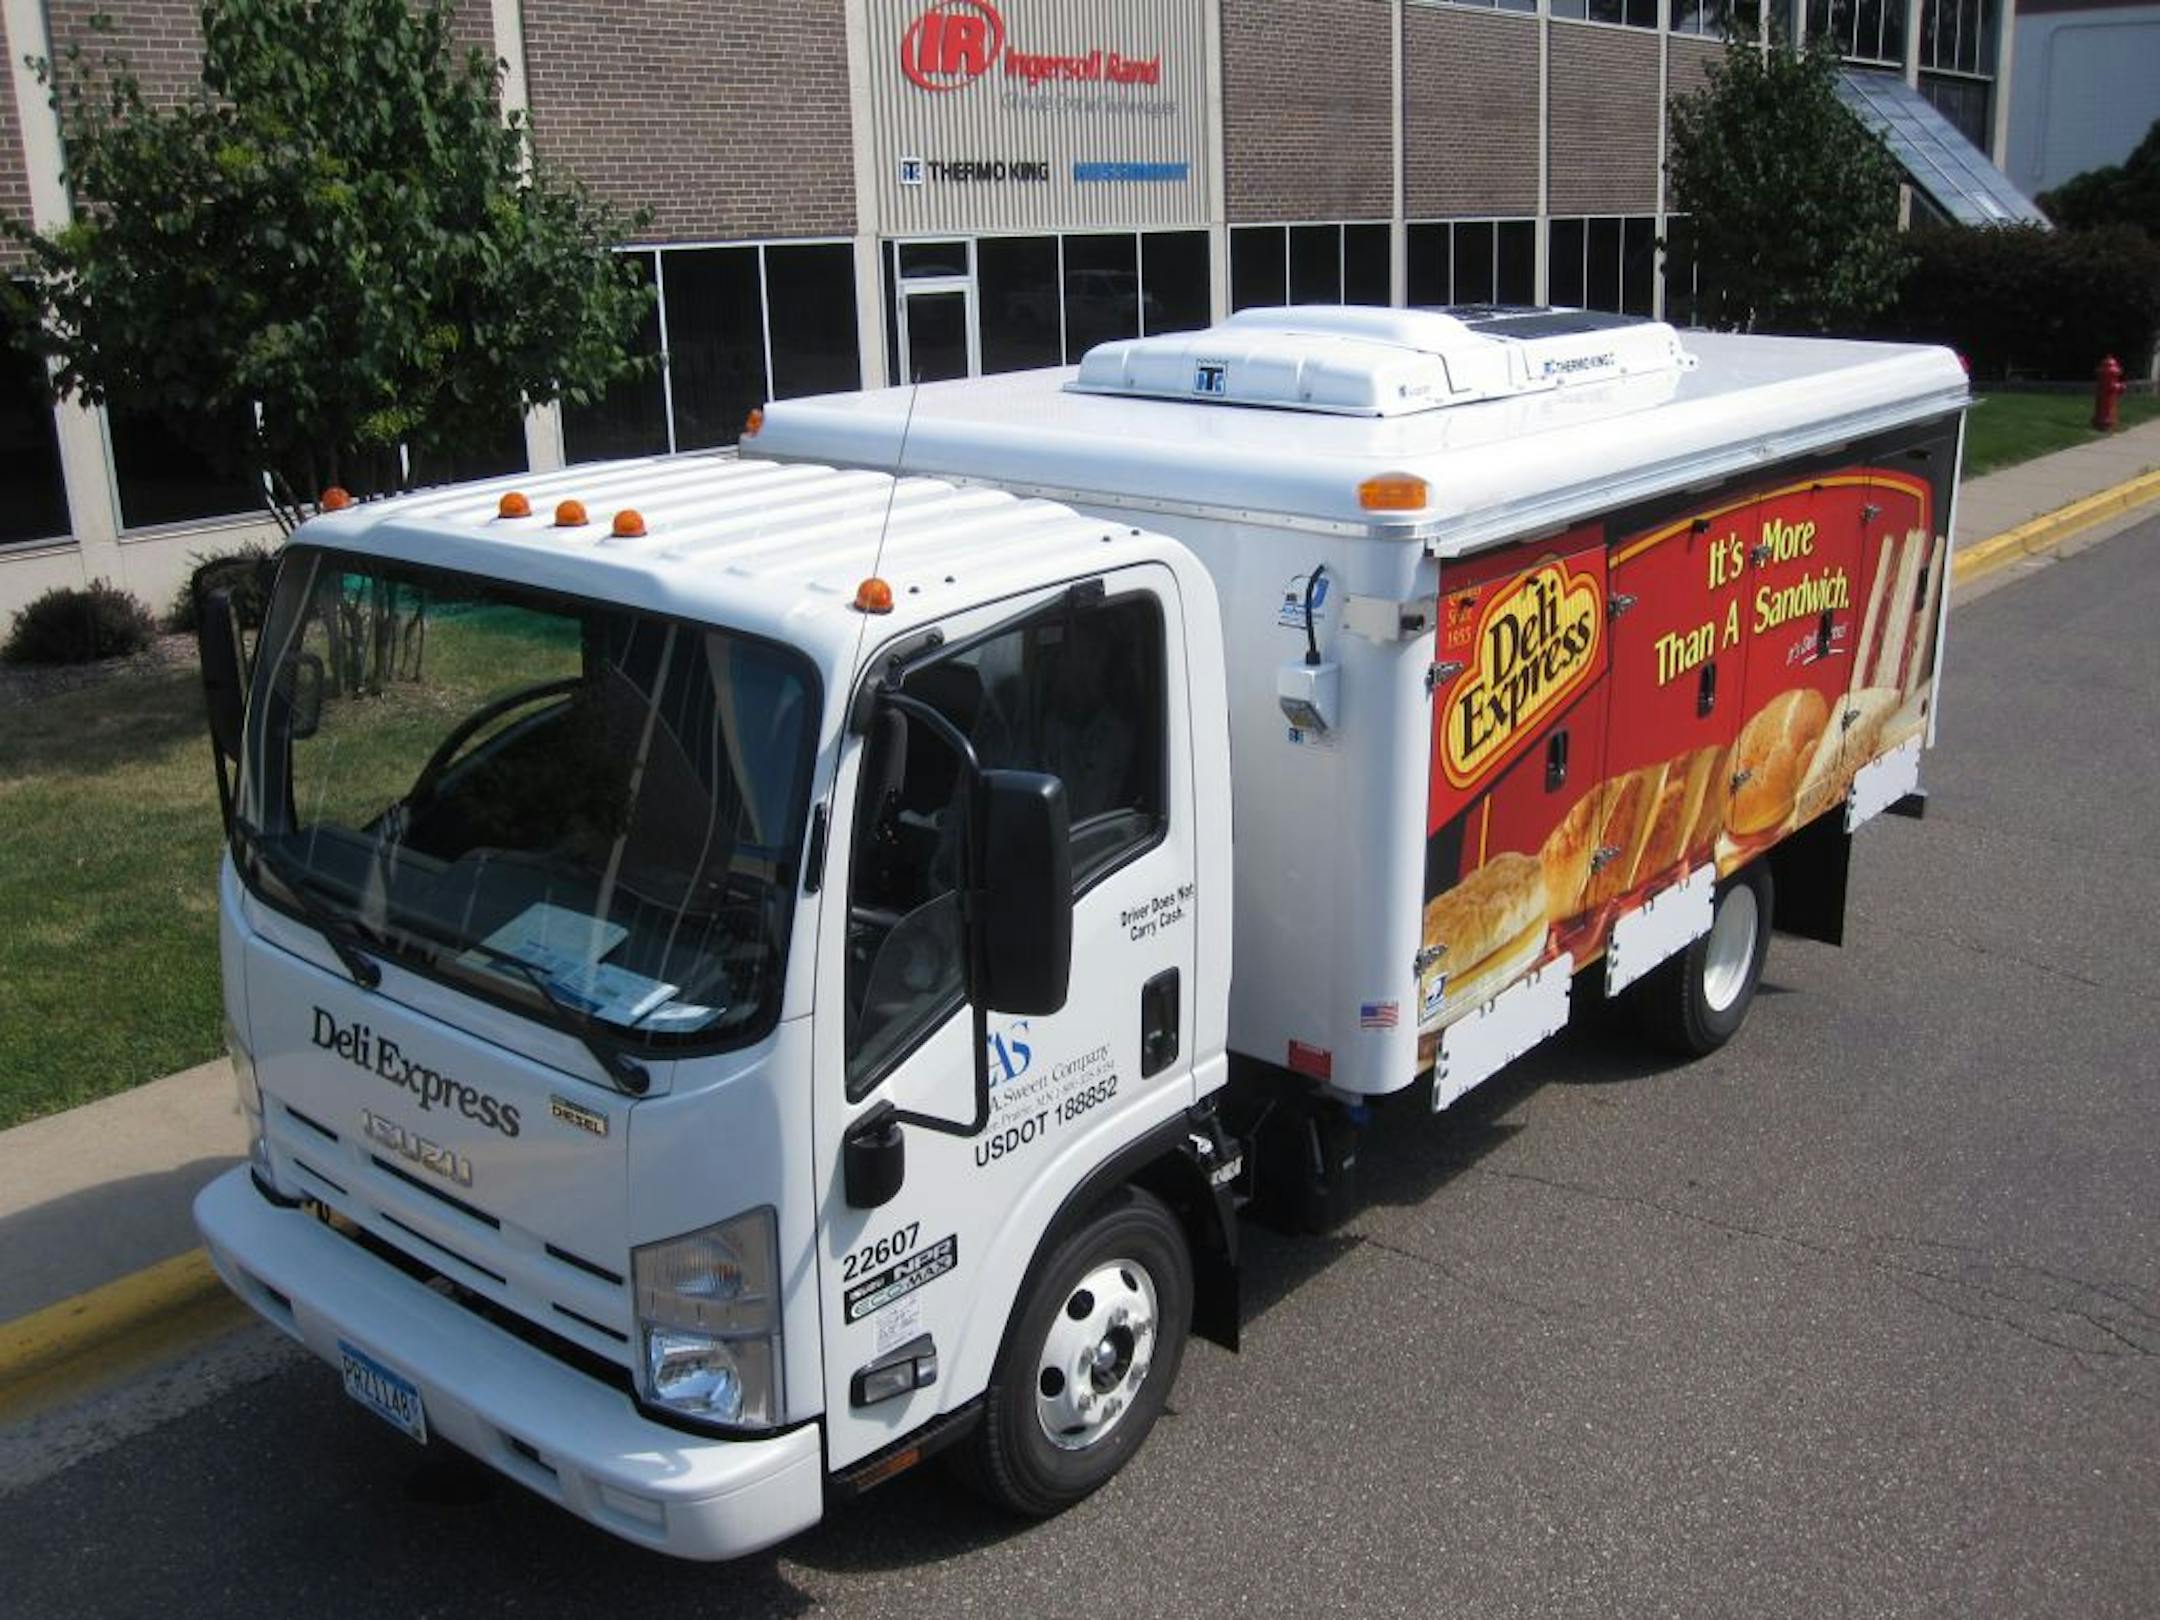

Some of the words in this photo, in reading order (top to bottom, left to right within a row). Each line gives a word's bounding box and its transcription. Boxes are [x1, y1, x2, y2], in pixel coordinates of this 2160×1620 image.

[919, 13, 985, 75] IR
[1005, 49, 1101, 85] Ingersoll
[1107, 53, 1160, 84] Rand
[928, 161, 1006, 182] THERMO
[1009, 161, 1049, 181] KING
[1708, 532, 1744, 590] It's
[1761, 517, 1816, 568] More
[1488, 578, 1559, 690] Deli
[1655, 621, 1715, 686] Than
[1722, 599, 1740, 649] A
[1753, 566, 1850, 634] Sandwich.
[1459, 609, 1590, 761] Express
[1121, 903, 1150, 928] Driver
[1151, 893, 1175, 914] Does
[1177, 882, 1193, 900] Not
[1130, 920, 1157, 941] Carry
[312, 1006, 372, 1071] Deli
[375, 1037, 520, 1138] Express
[1052, 1047, 1109, 1083] Company
[361, 1108, 473, 1188] ISUZU
[975, 1110, 1048, 1168] USDOT
[1056, 1075, 1118, 1126] 188852
[843, 1221, 920, 1283] 22607
[892, 1241, 953, 1281] NPR
